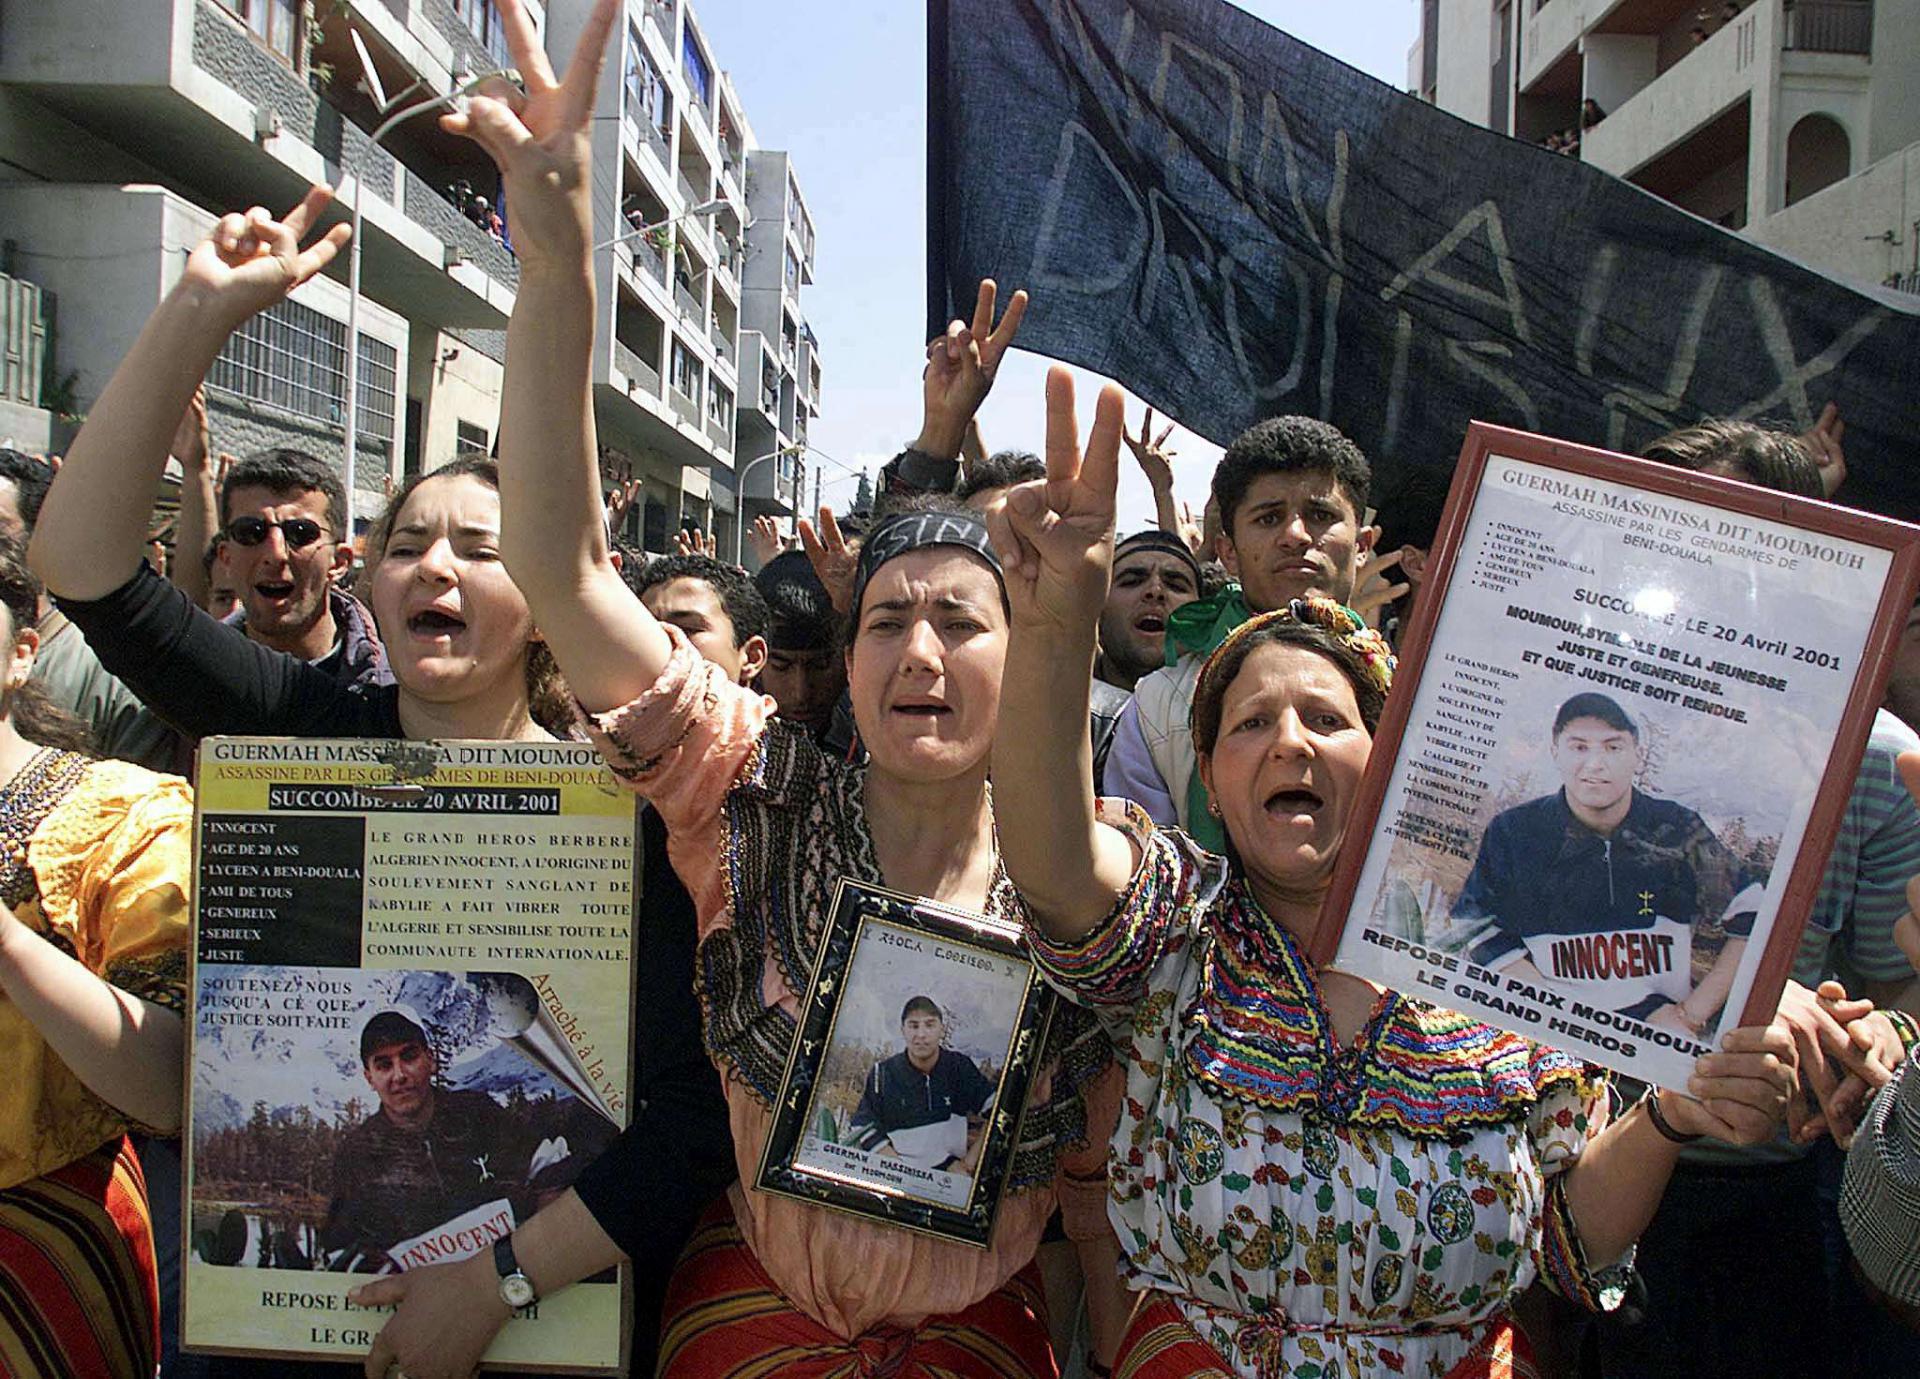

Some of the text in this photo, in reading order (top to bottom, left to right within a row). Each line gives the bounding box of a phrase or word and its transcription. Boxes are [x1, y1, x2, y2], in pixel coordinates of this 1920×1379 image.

[1500, 468, 1866, 570] GUERMAH MASSINISSA DIT MOUMOUH
[1551, 499, 1800, 571] ASSASSINE PAR LES GENDARMES DE
[1621, 532, 1715, 566] BENI-DOUALA
[1572, 586, 1843, 671] SUCCOE LE 20 Avril 2001
[1555, 638, 1605, 663] JUSTE
[1605, 652, 1628, 669] ET
[1657, 645, 1681, 663] DE
[1681, 651, 1704, 669] LA
[1704, 658, 1788, 692] JEUNESSE
[1520, 649, 1751, 724] ET QUE JUSTICE SOIT RENDUE.
[214, 743, 318, 761] GUERMAH
[459, 747, 496, 764] DIT
[501, 747, 606, 766] MOUMOU
[214, 765, 298, 781] ASSASSINE
[302, 767, 335, 781] PAR
[337, 767, 365, 782] LES
[477, 770, 500, 784] DE
[423, 791, 444, 810] 20
[448, 792, 513, 811] AVRIL
[518, 793, 558, 812] 2001
[210, 821, 276, 834] INNOCENT
[370, 831, 632, 848] LE GRAND HEROS BERBERE
[208, 843, 299, 856] AGE DE 20 ANS
[369, 853, 440, 866] ALGERIEN
[522, 856, 531, 868] A
[536, 857, 608, 870] L'ORIGINE
[611, 858, 631, 870] DU
[208, 864, 361, 879] LYCEEN A BENI-DOUALA
[207, 885, 293, 898] AMI DE TOUS
[368, 876, 630, 893] SOULEVEMENT SANGLANT DE
[207, 906, 276, 919] GENEREUX
[368, 898, 630, 916] KABYLIE A FAIT VIBRER TOUTE
[206, 927, 261, 940] SERIEUX
[367, 921, 629, 939] L'ALGERIE ET SENSIBILISE TOUTE LA
[205, 949, 244, 961] JUSTE
[366, 943, 628, 961] COMMUNAUTE INTERNATIONALE.
[1551, 934, 1674, 980] INNOCENT
[1360, 926, 1461, 974] REPOSE
[1464, 963, 1501, 988] EN
[1504, 978, 1567, 1011] PAIX
[305, 980, 352, 994] NOUS
[316, 998, 351, 1013] QUE
[1415, 969, 1639, 1059] LE GRAND HEROS
[201, 1012, 351, 1029] JUSTICE SOIT FAITE
[531, 973, 624, 1112] Arraché à la vie
[400, 1211, 514, 1271] INNOCENT
[261, 1290, 338, 1311] REPOSE
[310, 1327, 336, 1346] LE
